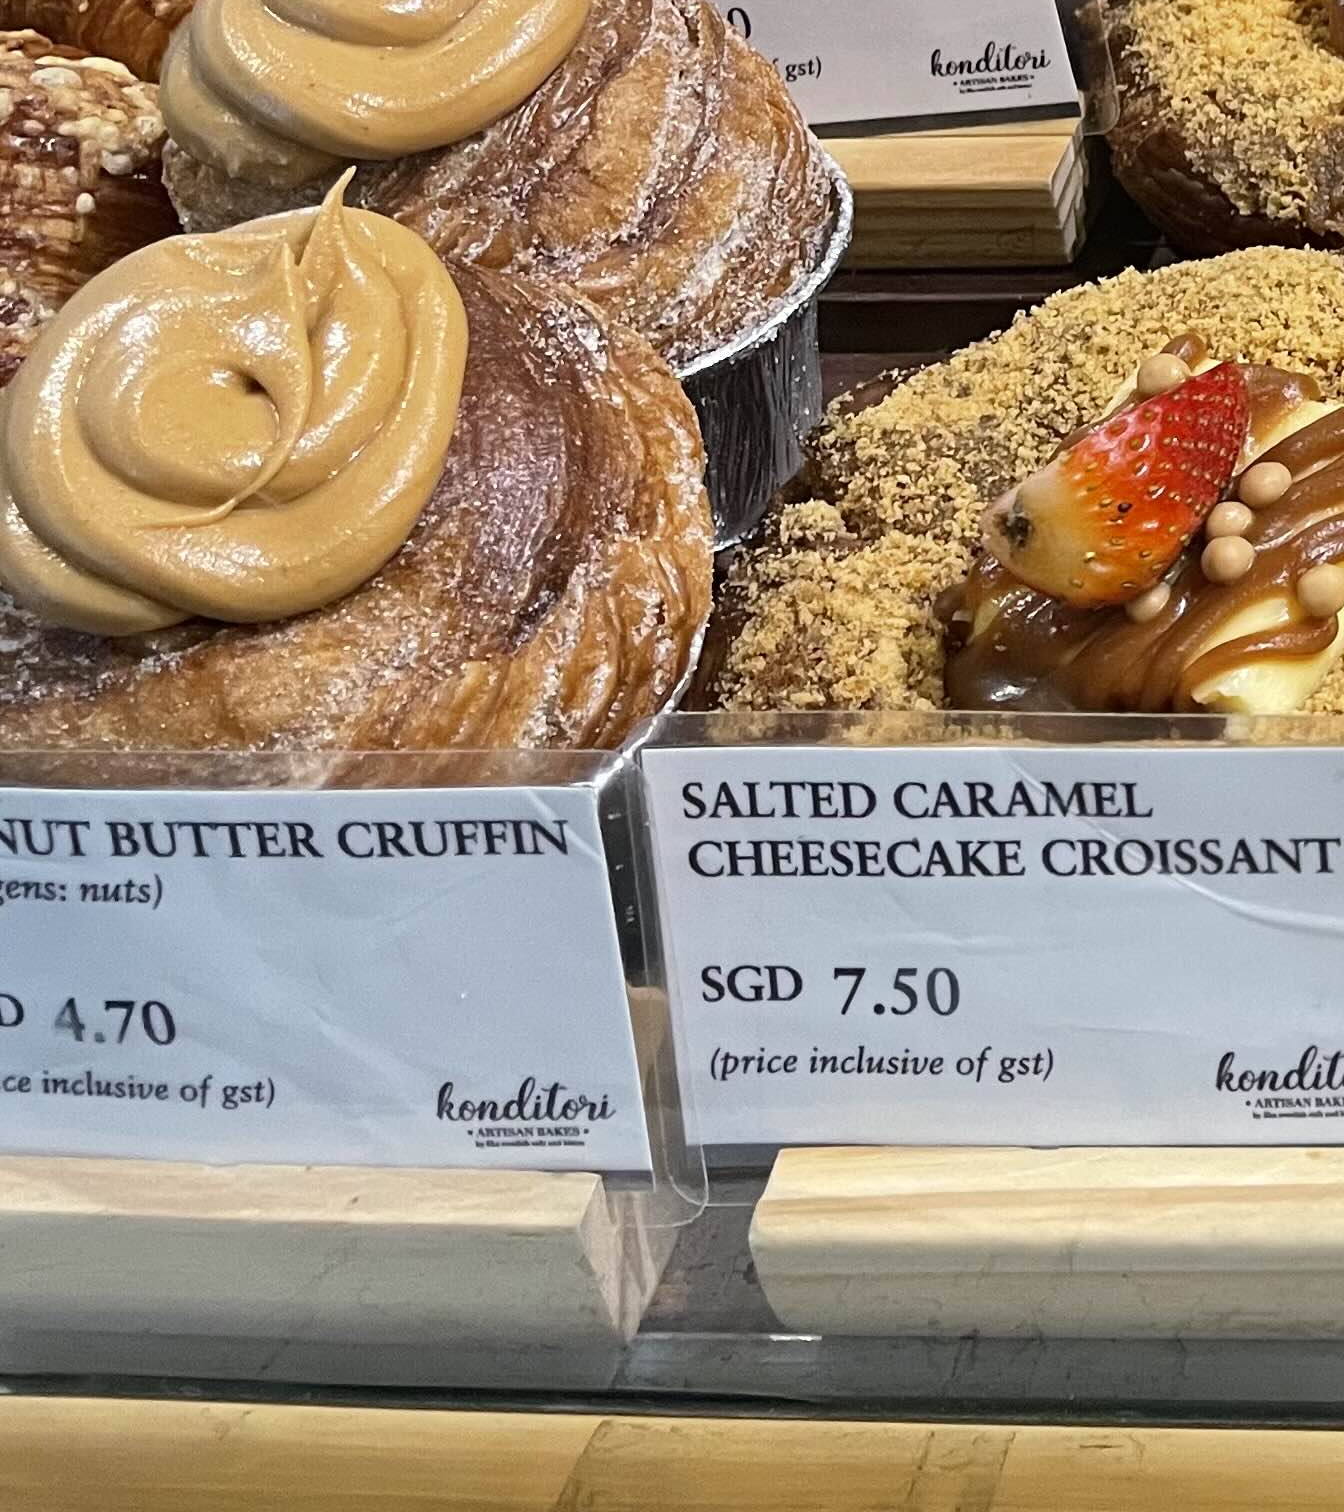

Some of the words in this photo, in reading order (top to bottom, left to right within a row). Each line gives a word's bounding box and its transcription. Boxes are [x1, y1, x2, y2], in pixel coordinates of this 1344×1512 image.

[785, 56, 822, 82] gst)
[930, 41, 1051, 76] konditori
[683, 781, 875, 820] SALTED
[892, 781, 1153, 819] CARAMEL
[104, 820, 325, 858] BUTTER
[336, 820, 568, 857] CRUFFIN
[687, 838, 1026, 877] CHEESECAKE
[1041, 837, 1341, 876] CROISSANT
[80, 874, 163, 910] nuts)
[702, 965, 803, 1002] SGD
[833, 967, 961, 1016] 7.50
[54, 997, 177, 1046] 4.70
[710, 1047, 800, 1081] (price
[809, 1046, 943, 1077] inclusive
[956, 1048, 991, 1084] of
[998, 1049, 1055, 1082] gst)
[43, 1070, 169, 1101] inclusive
[180, 1074, 213, 1108] of
[222, 1078, 275, 1110] gst)
[437, 1077, 616, 1121] konditori
[1255, 1098, 1311, 1109] ARTISAN
[477, 1127, 534, 1137] ARTISAN
[538, 1127, 580, 1137] BAKES
